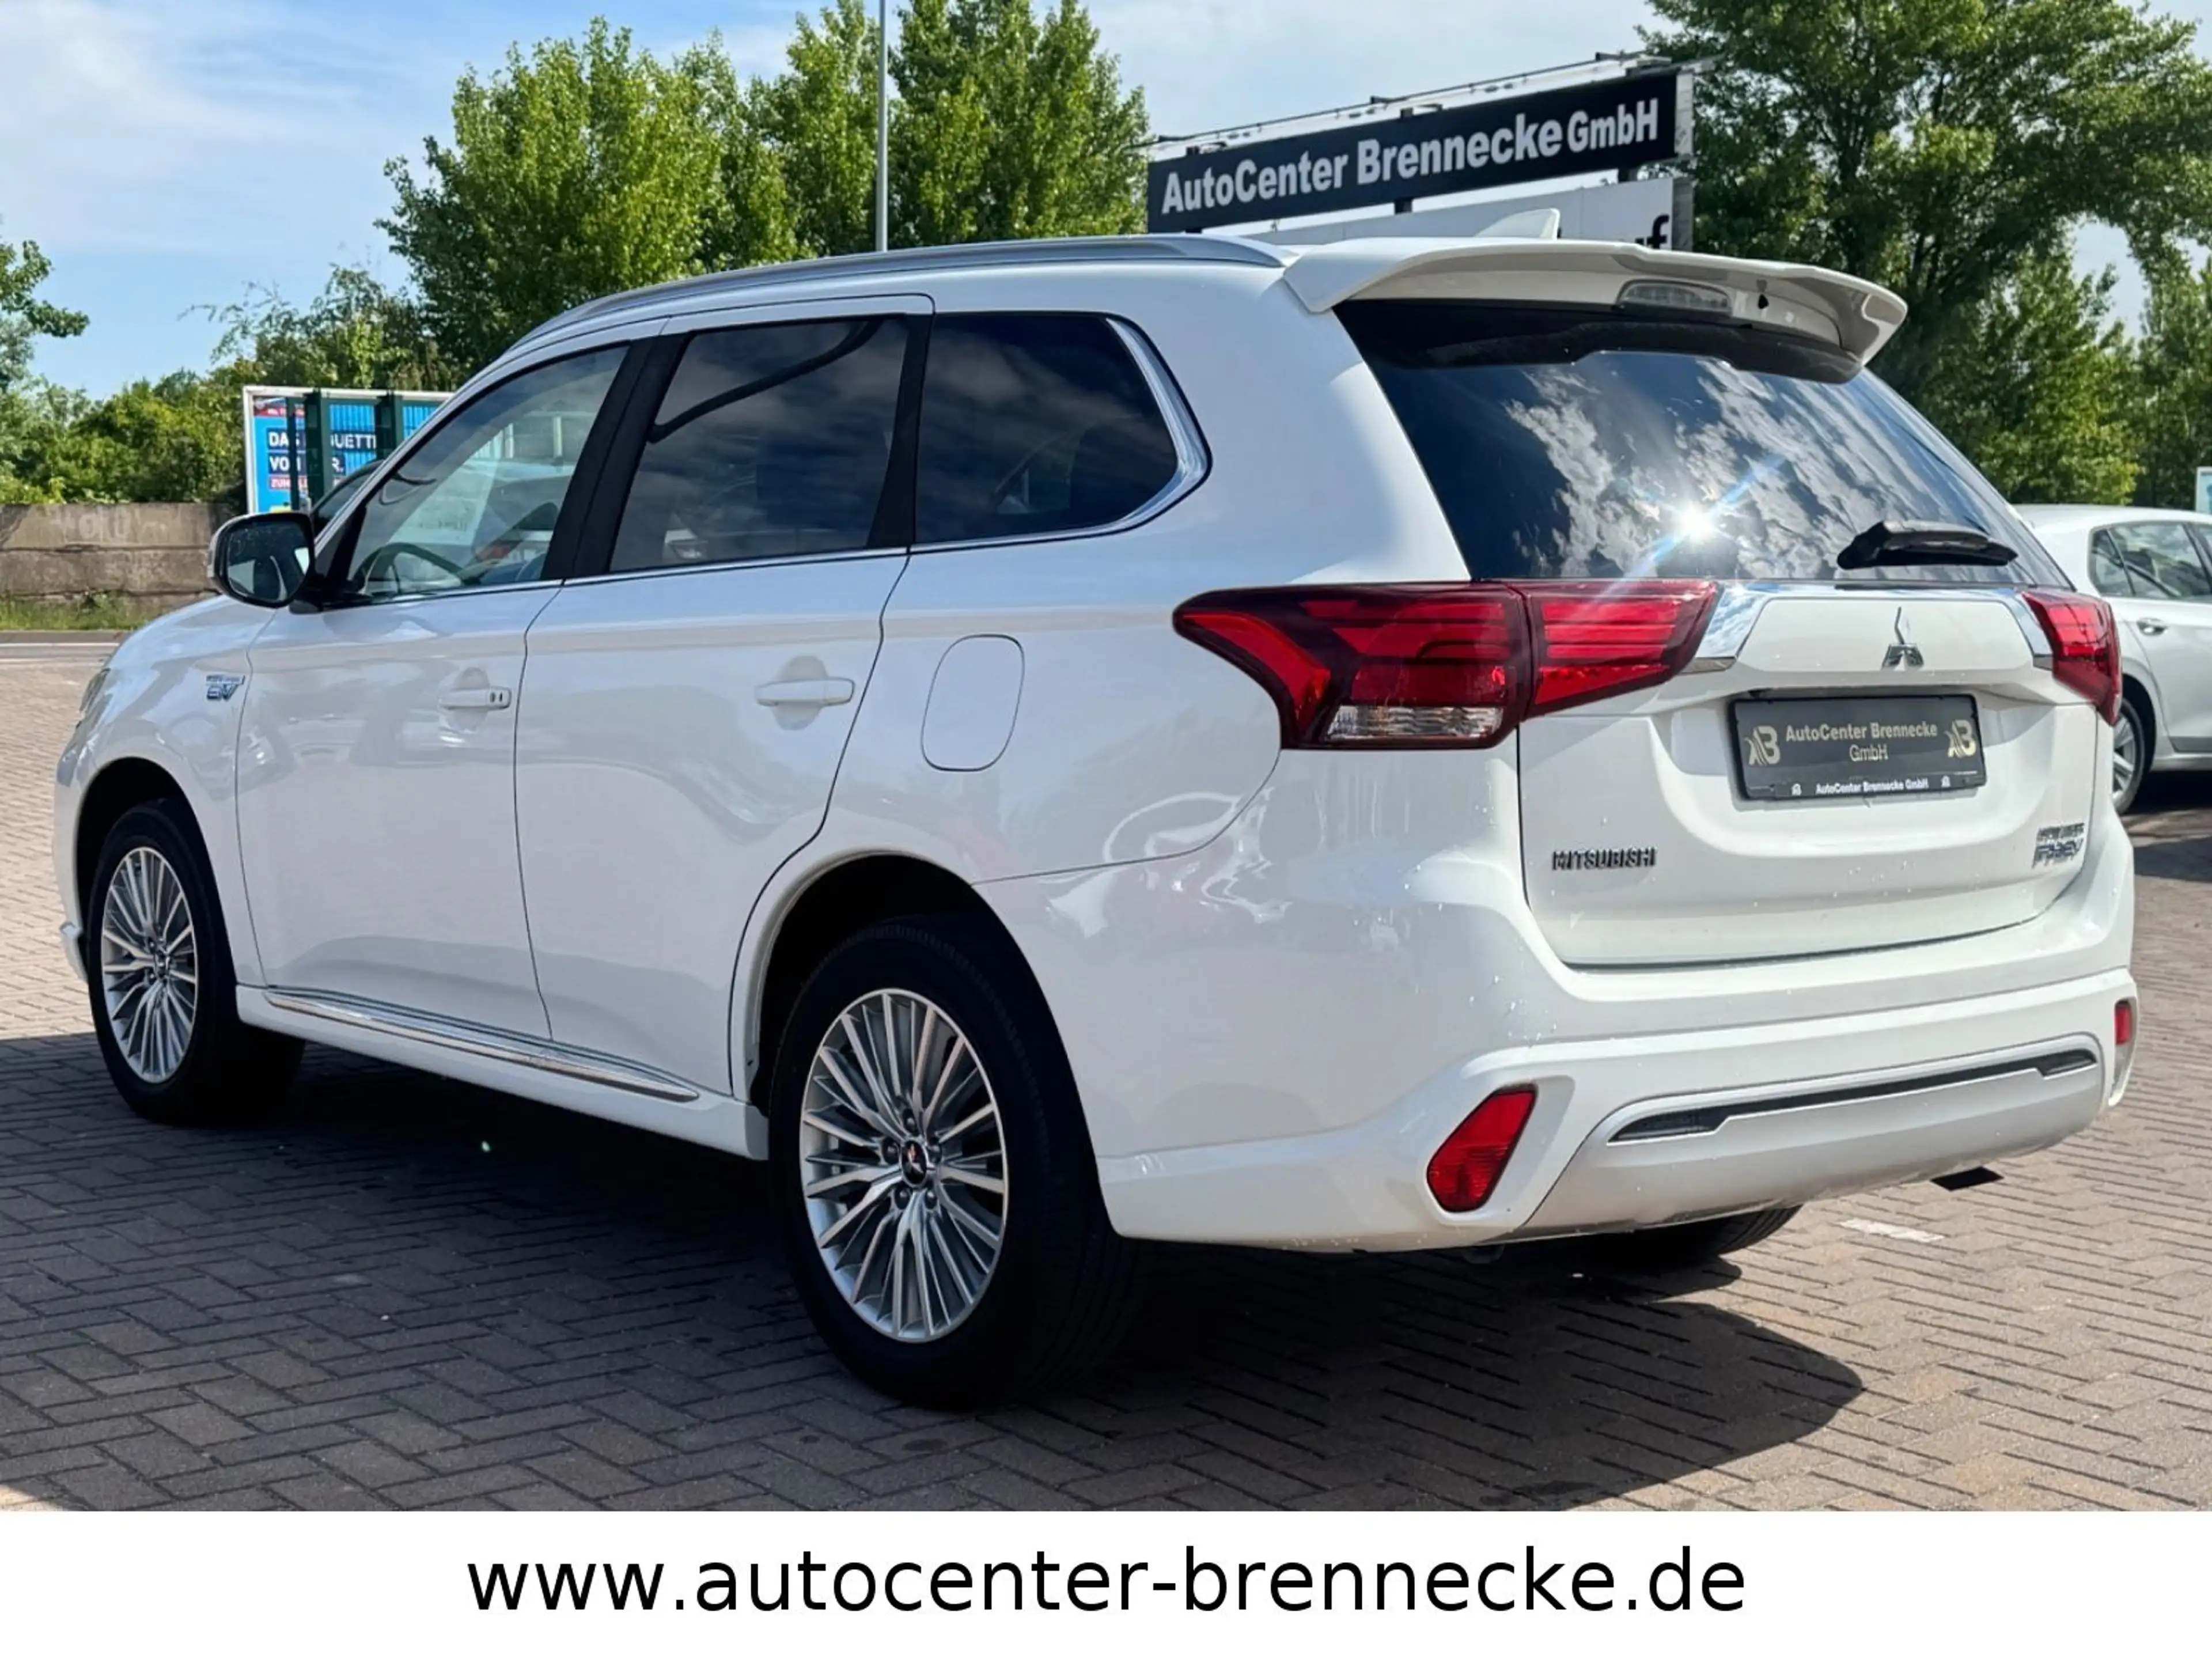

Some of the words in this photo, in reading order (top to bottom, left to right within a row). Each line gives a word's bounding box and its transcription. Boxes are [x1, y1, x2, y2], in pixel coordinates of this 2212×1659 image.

[1161, 150, 1349, 214] AutoCenter
[1357, 113, 1563, 185] Brennecke
[1567, 98, 1658, 153] GmbH
[1785, 723, 1868, 742] AutoCenter
[1870, 720, 1938, 739] Brennecke
[1849, 743, 1889, 762] GmbH
[1815, 782, 1862, 795] AutoCenter
[1905, 778, 1929, 790] GmbH
[1552, 847, 1657, 871] MITSUBISHI
